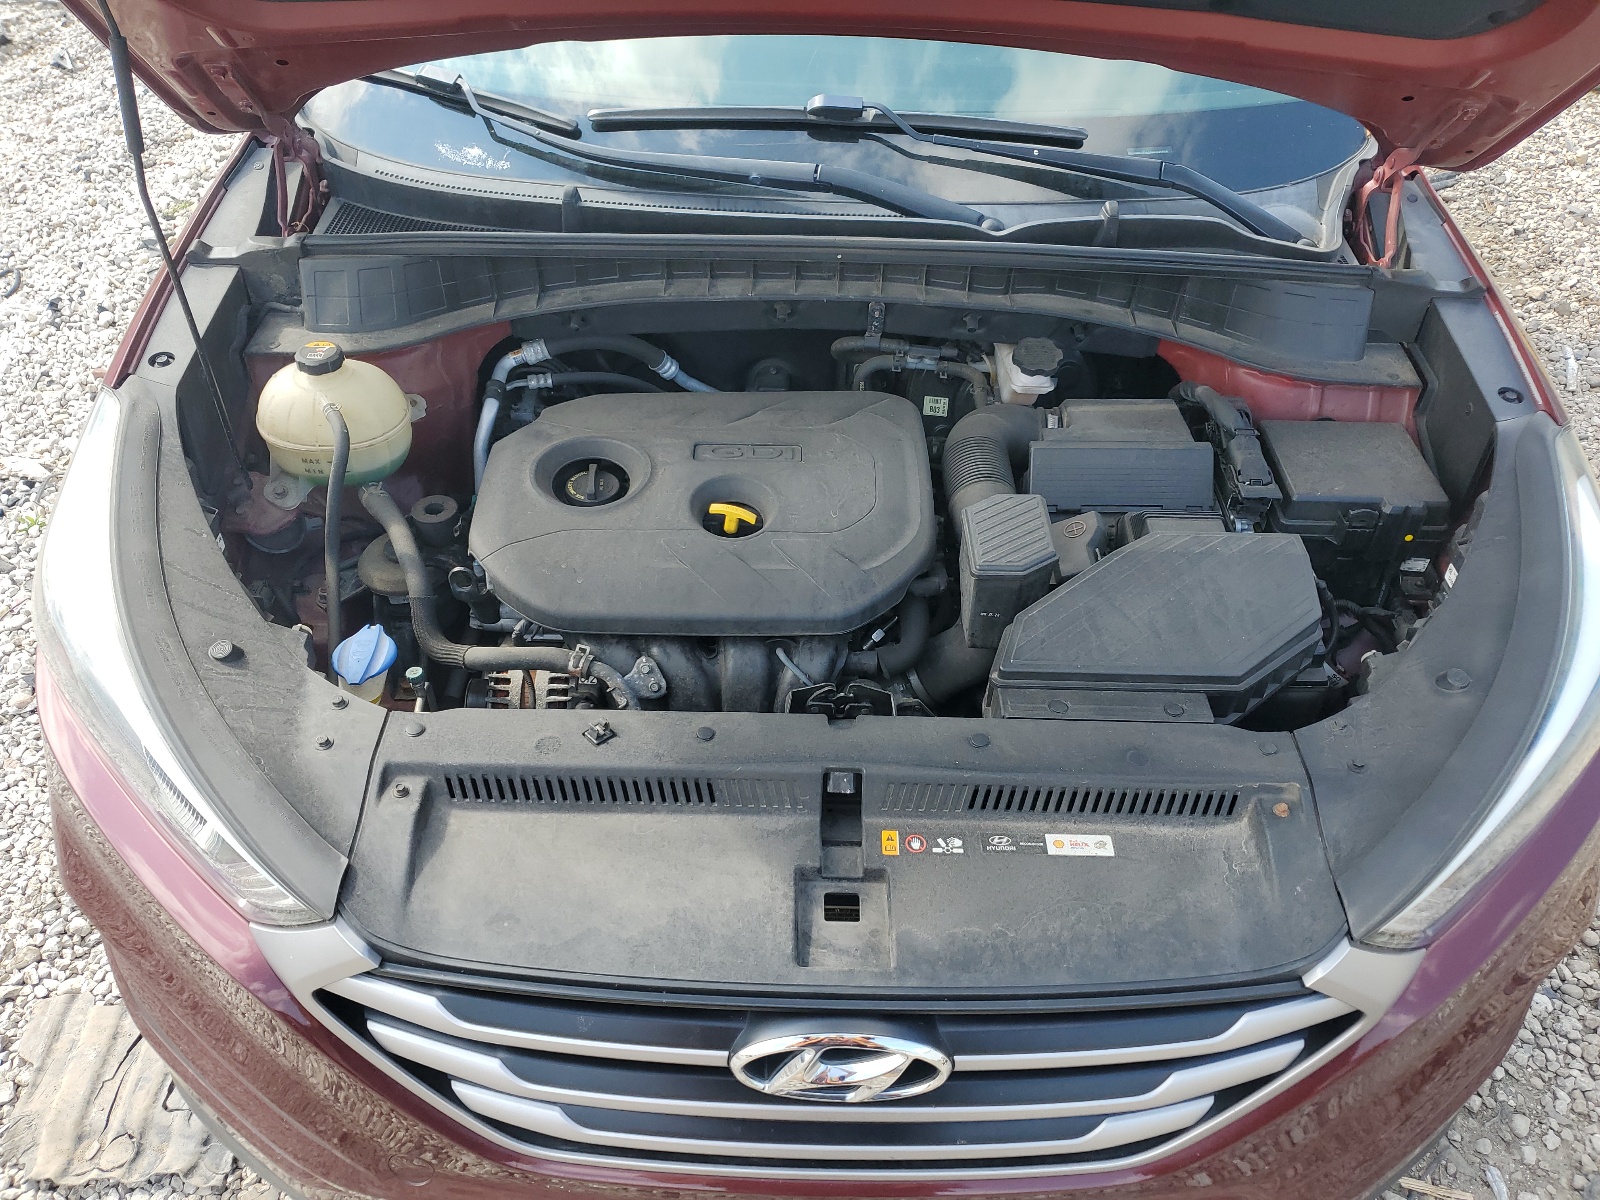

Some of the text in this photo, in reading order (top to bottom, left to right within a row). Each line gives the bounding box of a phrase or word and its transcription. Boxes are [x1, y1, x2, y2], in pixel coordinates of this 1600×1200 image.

[711, 446, 795, 461] GDI
[301, 457, 321, 465] MAX
[304, 467, 324, 475] MIN
